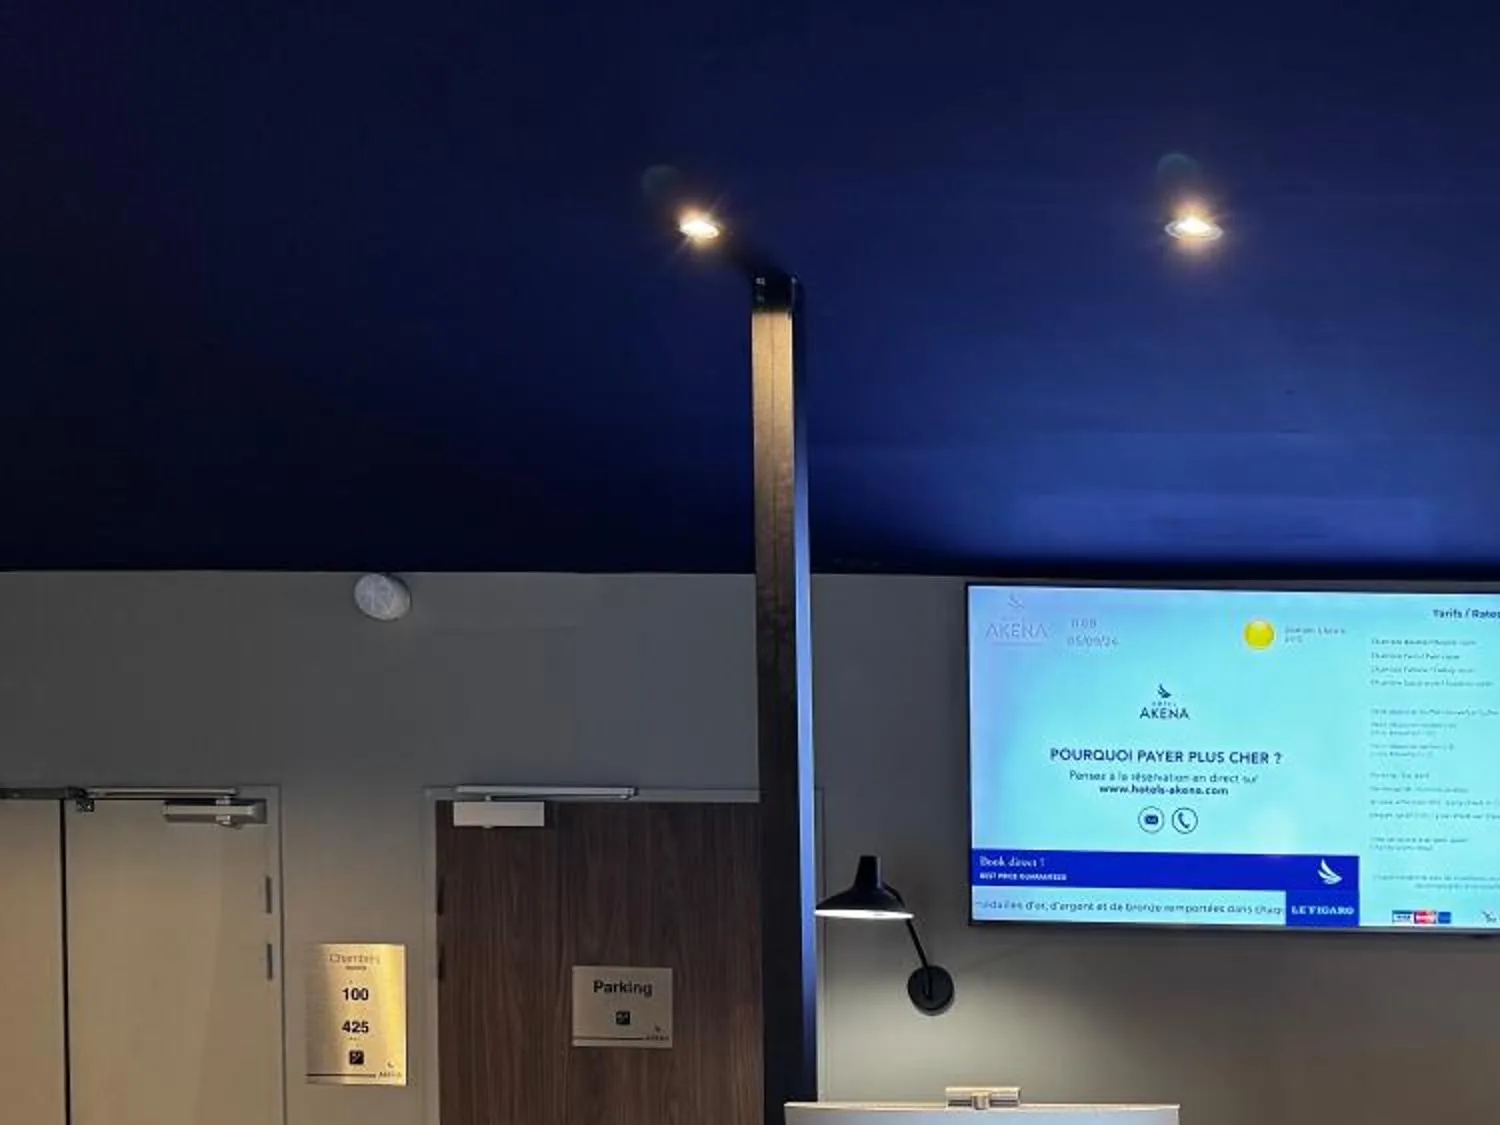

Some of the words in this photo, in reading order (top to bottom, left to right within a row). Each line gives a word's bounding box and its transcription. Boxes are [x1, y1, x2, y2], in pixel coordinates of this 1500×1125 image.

[1432, 608, 1463, 618] Tarifs
[983, 622, 1048, 640] AKENA
[1140, 707, 1190, 720] AKENA
[1049, 748, 1133, 761] POURQUOI
[1137, 750, 1184, 763] PAYER
[1188, 751, 1225, 764] PLUS
[1229, 751, 1269, 765] CHER
[1273, 752, 1282, 765] ?
[1069, 769, 1106, 781] Pensez
[1192, 775, 1207, 783] en
[1209, 774, 1239, 783] direct
[1099, 783, 1229, 795] www.hotels-akena.com
[979, 856, 1006, 867] Book
[1050, 901, 1094, 913] d'argent
[1097, 902, 1107, 911] et
[1109, 903, 1123, 911] de
[1291, 905, 1306, 915] LE
[1308, 905, 1355, 915] FIGARO
[342, 987, 369, 1001] 100
[593, 980, 653, 997] Parking
[341, 1020, 369, 1033] 425
